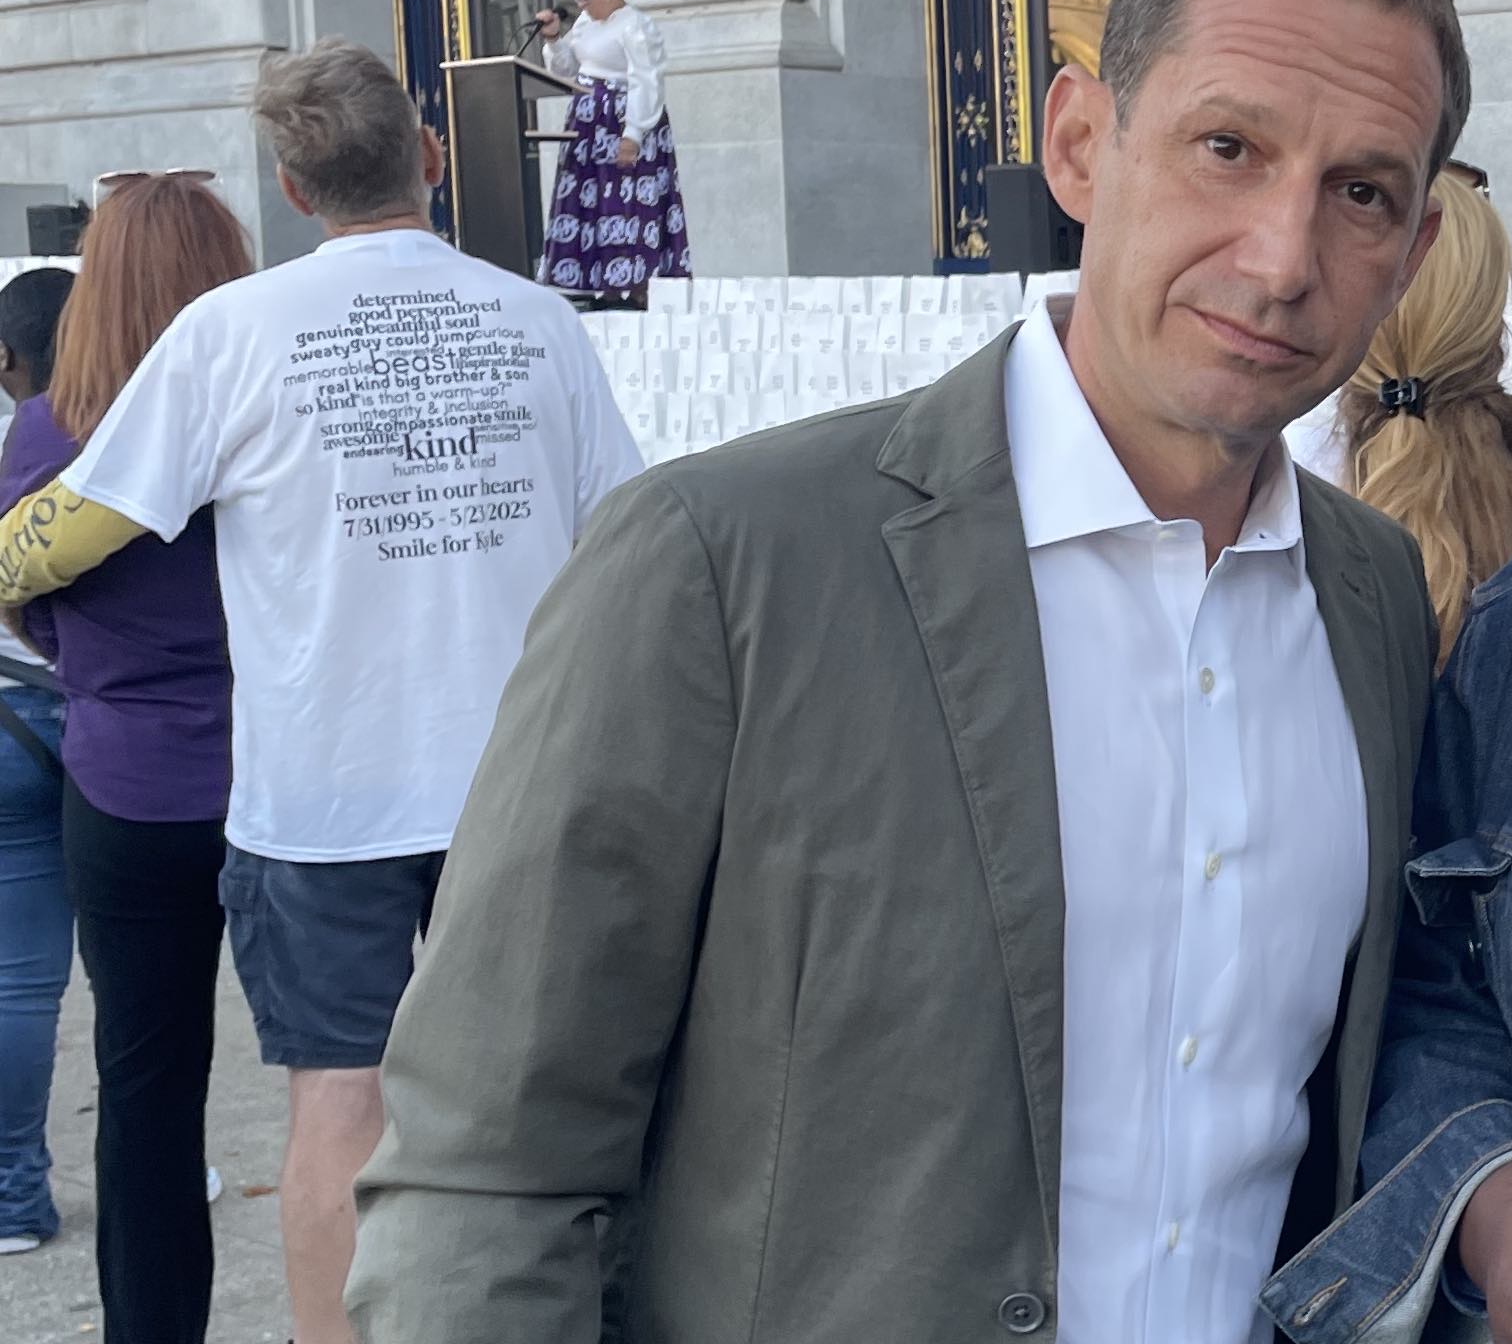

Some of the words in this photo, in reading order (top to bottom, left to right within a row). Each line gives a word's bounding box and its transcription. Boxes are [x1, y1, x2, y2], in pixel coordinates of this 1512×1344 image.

[353, 289, 456, 308] determined
[456, 299, 501, 314] loved
[348, 304, 392, 325] good
[397, 304, 456, 323] person
[365, 316, 441, 336] beautiful
[445, 314, 480, 330] soul
[295, 323, 364, 348] genuine
[350, 336, 381, 354] guy
[386, 330, 429, 347] could
[434, 329, 475, 348] jump
[475, 327, 524, 340] curious
[290, 343, 351, 364] sweaty
[458, 341, 507, 359] gentle
[510, 342, 545, 358] giant
[283, 358, 374, 387] memorable
[370, 347, 460, 376] beast
[318, 378, 350, 397] real
[355, 375, 390, 392] kind
[396, 373, 421, 390] big
[425, 369, 485, 386] brother
[505, 370, 529, 381] son
[294, 402, 313, 417] so
[316, 394, 356, 414] kind
[379, 389, 409, 404] that
[416, 391, 426, 402] a
[444, 397, 508, 414] inclusion
[320, 417, 376, 436] strong
[375, 412, 491, 434] compassionate
[323, 431, 400, 451] awesome
[403, 427, 478, 461] kind
[393, 460, 448, 477] humble
[454, 457, 465, 470] &
[470, 454, 496, 469] kind
[336, 489, 411, 512] Forever
[416, 484, 438, 503] in
[443, 482, 478, 500] our
[480, 478, 534, 497] hearts
[377, 538, 437, 561] Smile
[442, 534, 471, 555] for
[475, 529, 504, 554] Kyle
